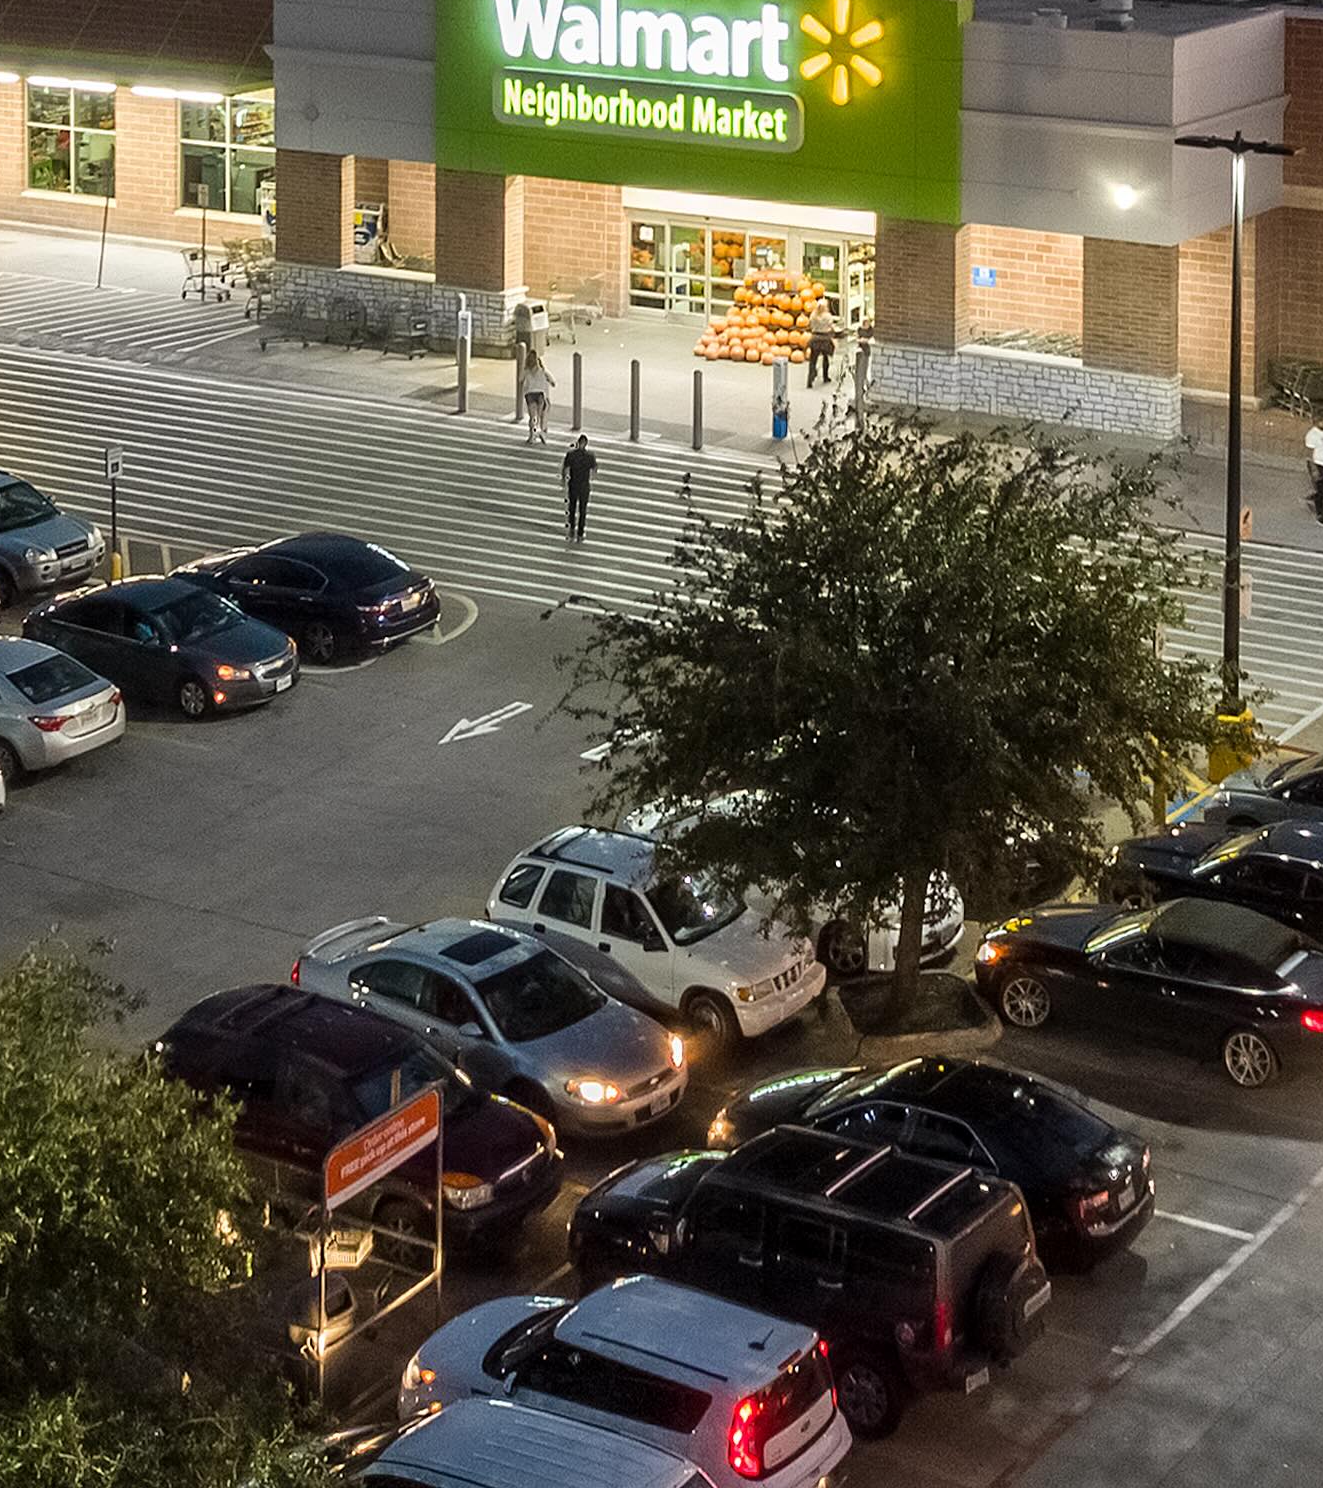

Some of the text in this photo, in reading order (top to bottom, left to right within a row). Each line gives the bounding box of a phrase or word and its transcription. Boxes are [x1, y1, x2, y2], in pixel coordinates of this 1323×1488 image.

[503, 78, 788, 142] Neighborhood Market
[341, 1157, 360, 1179] FREE
